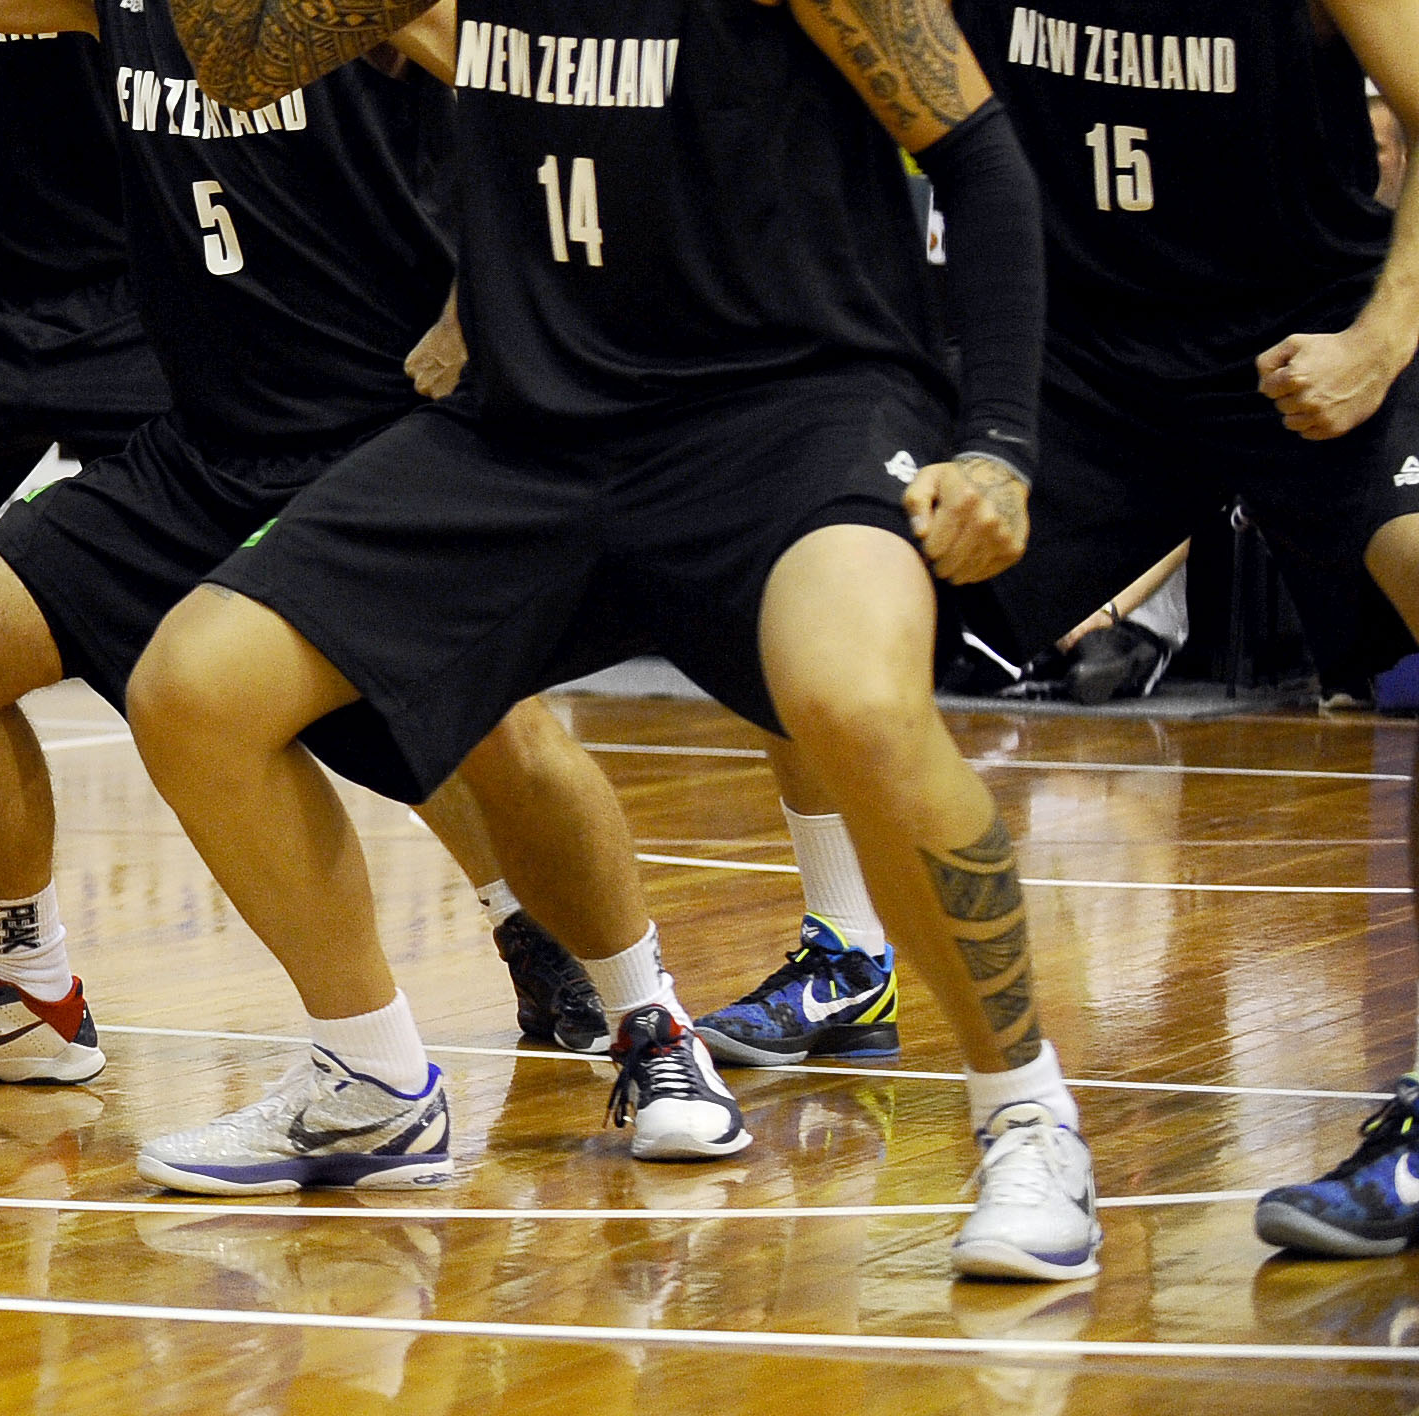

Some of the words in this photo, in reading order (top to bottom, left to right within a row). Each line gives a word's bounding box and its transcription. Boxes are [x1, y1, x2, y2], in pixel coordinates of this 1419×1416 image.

[1008, 6, 1077, 76] NEW
[1084, 25, 1237, 94] ZEALAND
[116, 66, 162, 132] EW
[537, 154, 604, 267] 14
[1085, 123, 1154, 211] 15
[192, 180, 244, 275] 5
